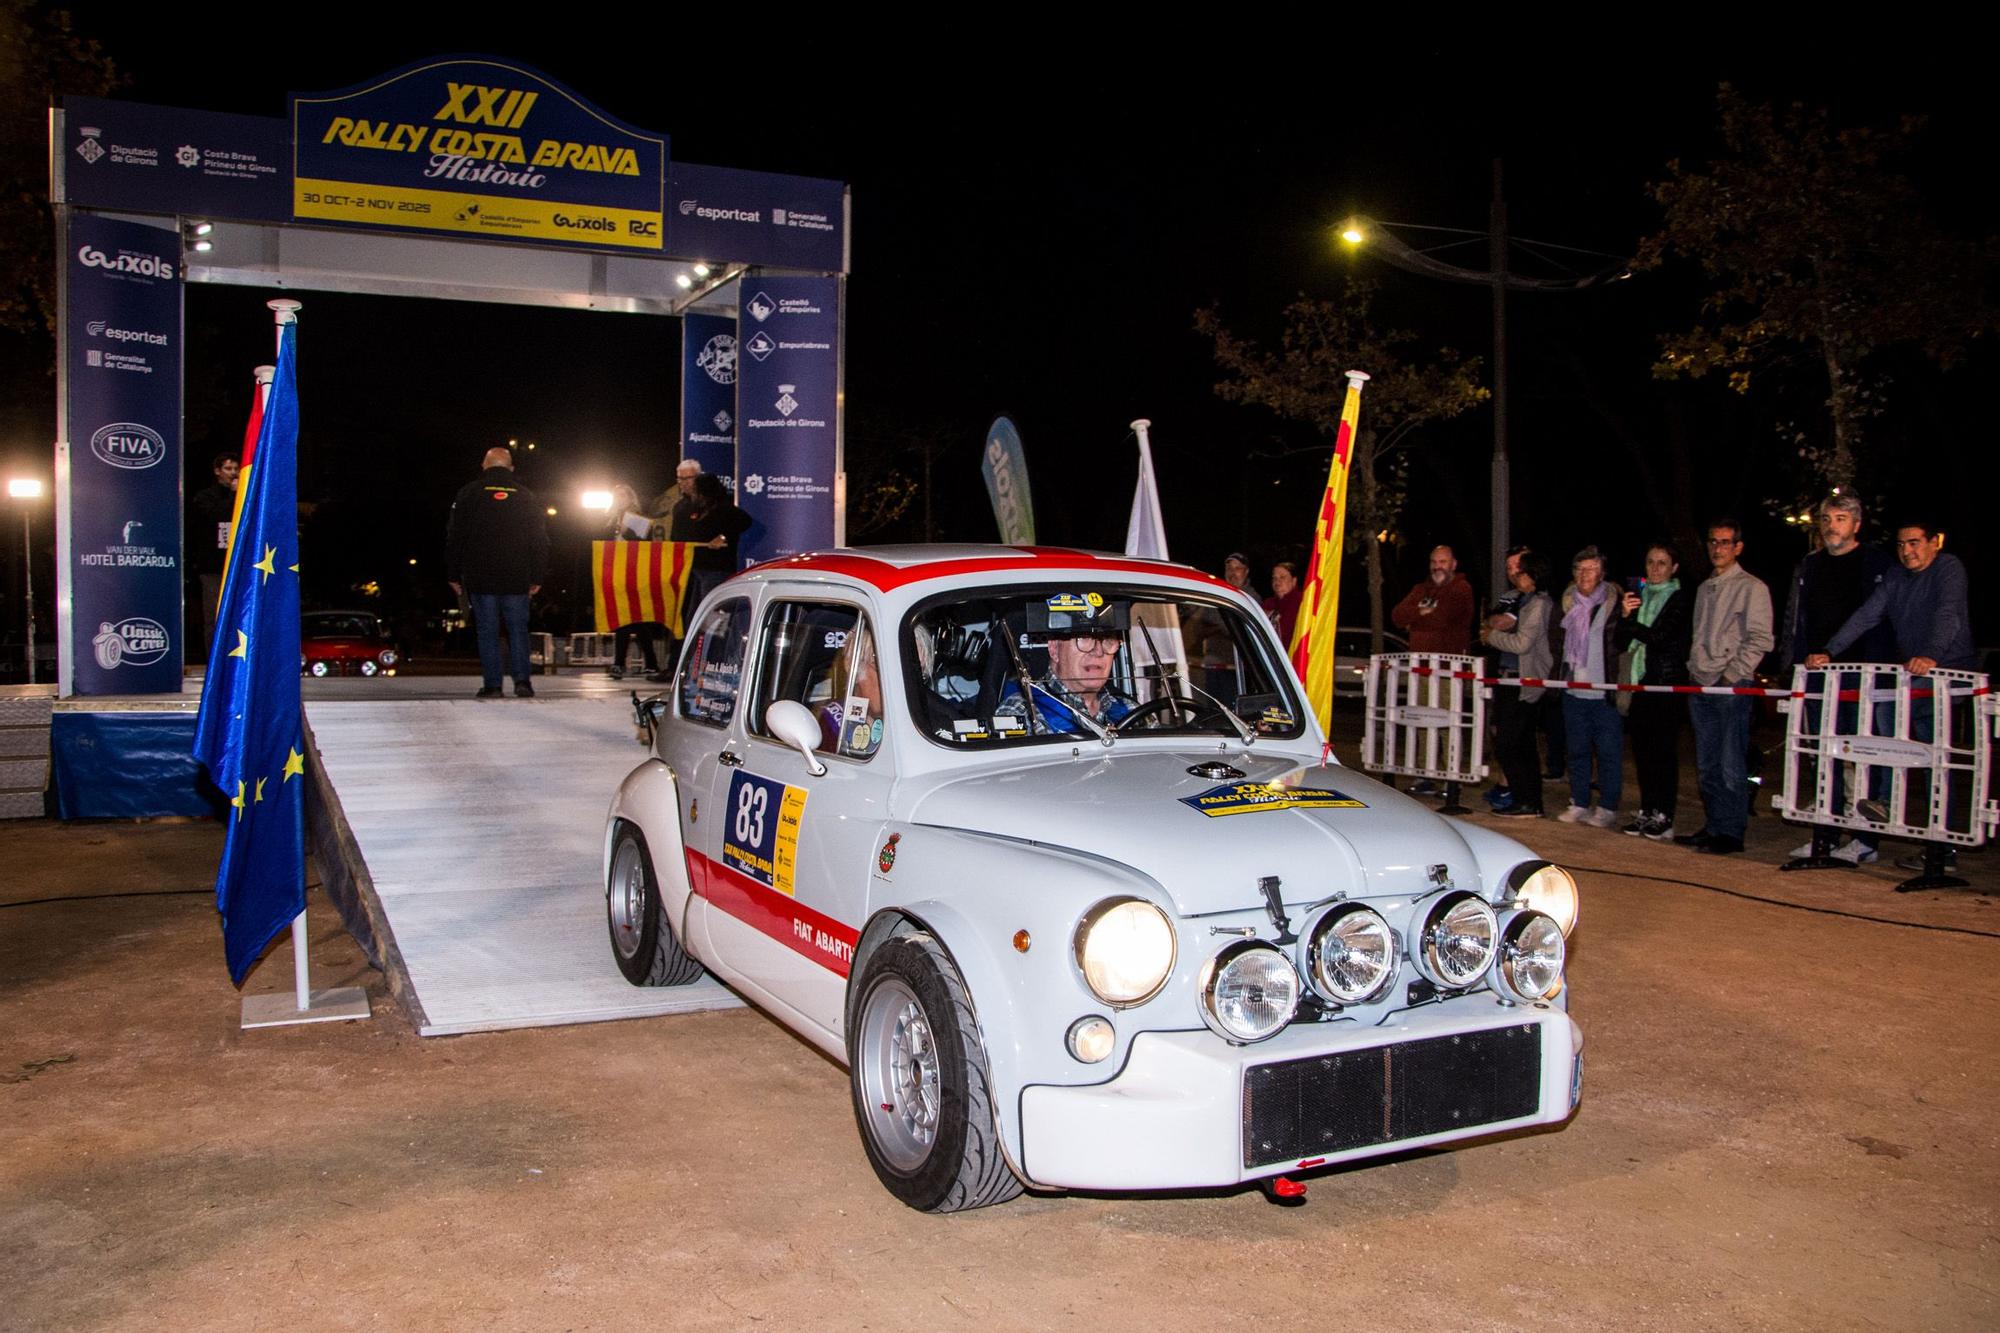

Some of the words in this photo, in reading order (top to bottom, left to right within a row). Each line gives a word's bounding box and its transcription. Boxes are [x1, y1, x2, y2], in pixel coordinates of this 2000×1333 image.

[433, 82, 539, 128] XXII
[111, 144, 158, 157] Diputació
[322, 116, 429, 153] RALLY
[429, 129, 526, 164] COSTA
[531, 139, 641, 176] BRAVA
[110, 154, 123, 162] de
[125, 155, 158, 166] Girona
[204, 149, 229, 159] Costa
[231, 152, 257, 161] Brava
[204, 159, 235, 169] Pirineu
[248, 163, 277, 173] Girona
[423, 153, 548, 188] Històric
[303, 193, 320, 203] 30
[368, 199, 394, 210] NOV
[397, 201, 431, 214] 2025
[696, 207, 761, 223] esportcat
[788, 211, 827, 222] Generalitat
[788, 219, 797, 227] de
[799, 220, 834, 231] Catalunya
[105, 328, 168, 346] esportcat
[779, 341, 830, 350] Empuriabrava
[104, 352, 146, 364] Generalitat
[116, 362, 153, 374] Catalunya
[748, 418, 786, 428] Diputació
[786, 418, 797, 427] de
[798, 418, 825, 427] Girona
[689, 432, 732, 444] Ajuntament
[107, 436, 152, 455] FIVA
[767, 484, 794, 492] Pirineu
[805, 485, 830, 493] Girona
[105, 545, 123, 554] VAN
[123, 546, 138, 554] DER
[138, 546, 156, 555] VALK
[81, 554, 116, 566] HOTEL
[117, 555, 175, 567] BARCAROLA
[121, 624, 164, 639] Classic
[735, 782, 768, 848] 83
[793, 917, 813, 943] FIAT
